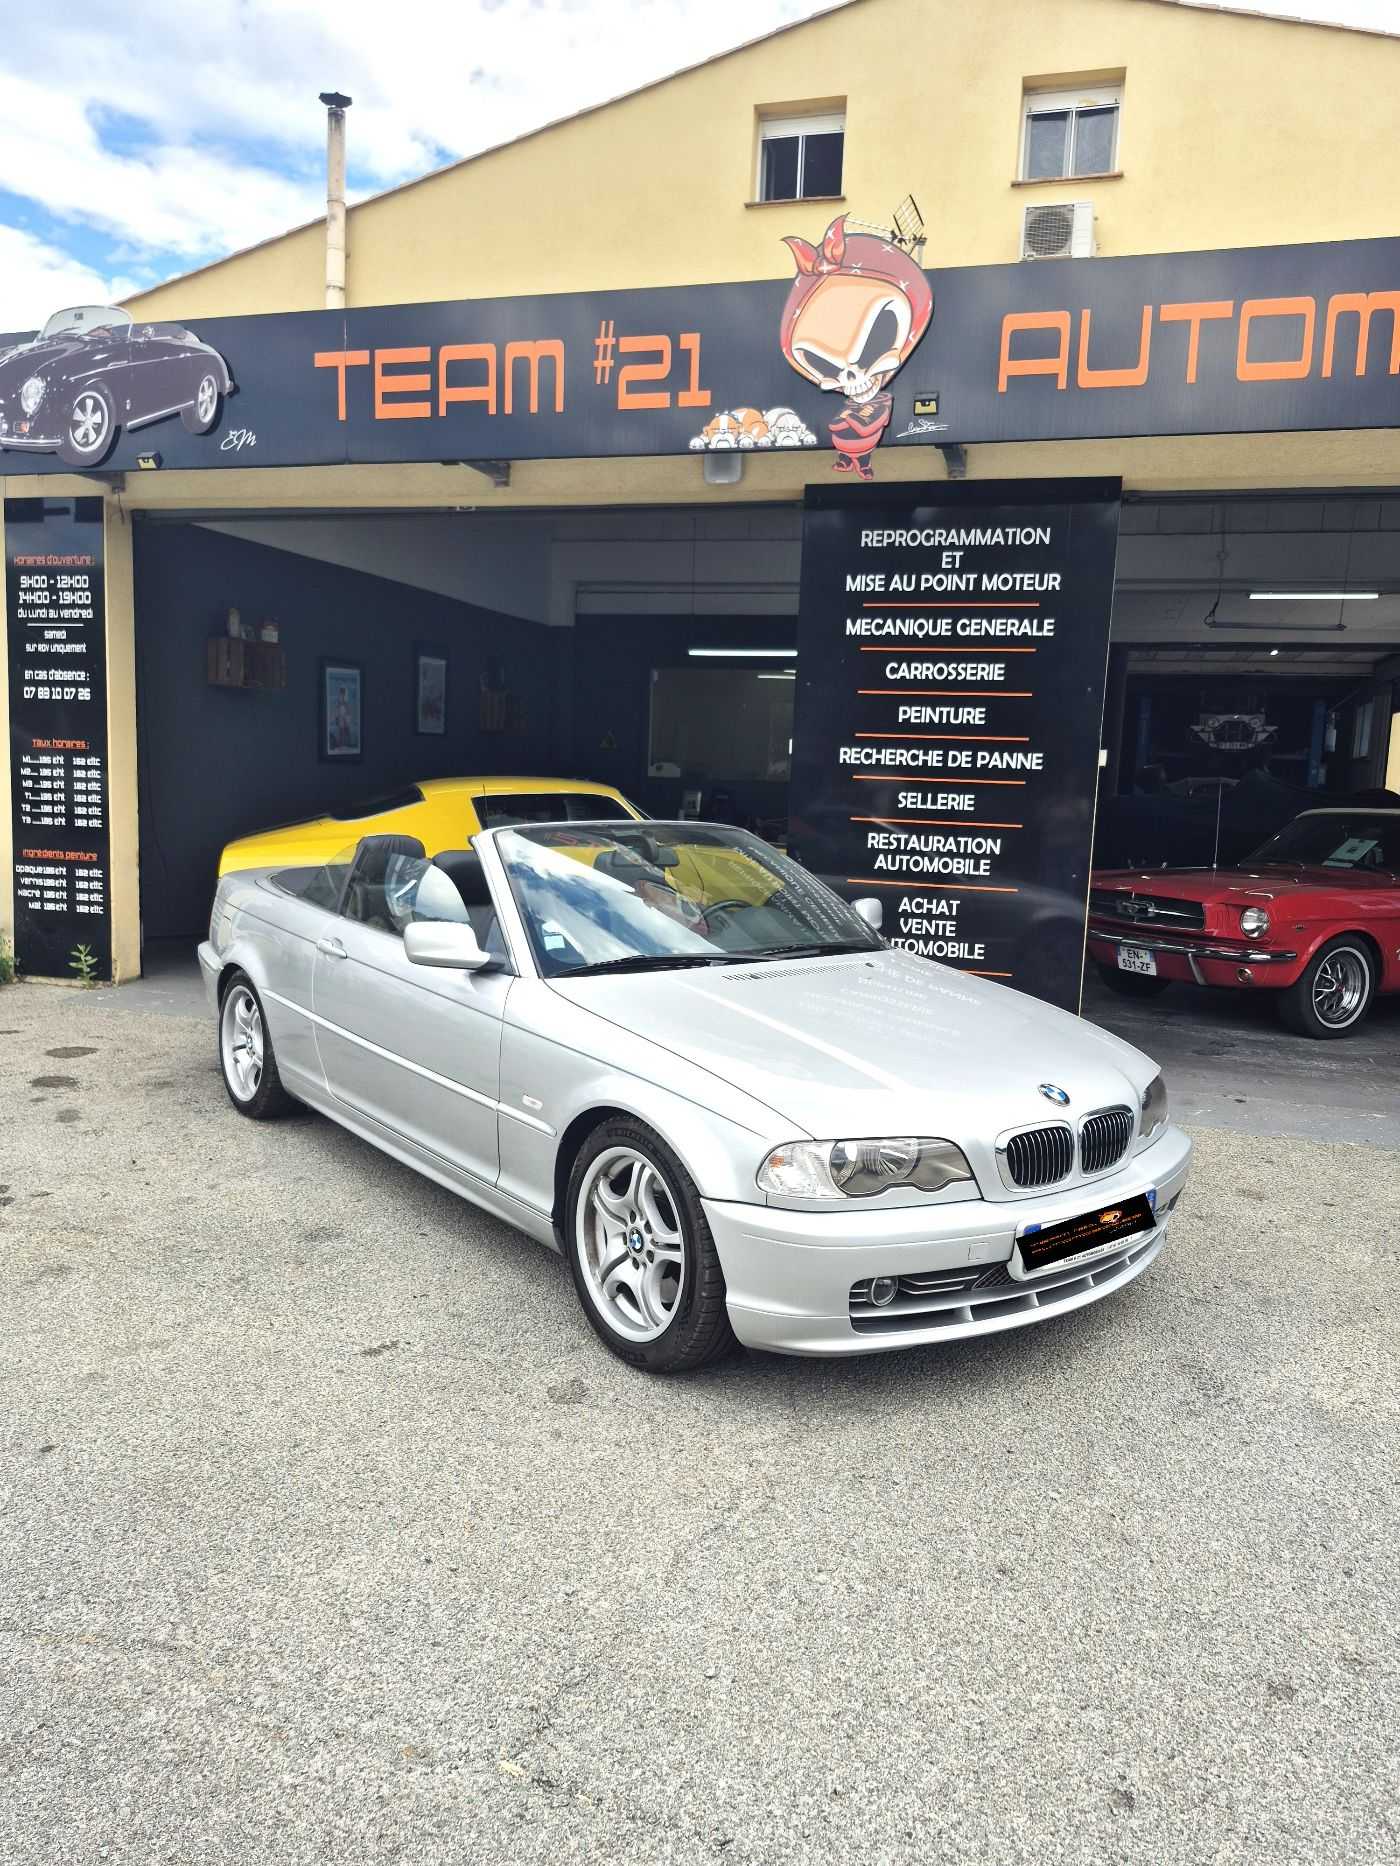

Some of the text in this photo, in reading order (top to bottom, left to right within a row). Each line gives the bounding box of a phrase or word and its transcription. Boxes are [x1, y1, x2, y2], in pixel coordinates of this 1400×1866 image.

[998, 290, 1400, 392] AUTOM
[314, 320, 711, 421] TEAM #21
[861, 527, 1051, 547] REPROGRAMMATION
[941, 551, 963, 568] ET
[20, 575, 47, 588] 9H00
[56, 575, 89, 588] 12H00
[845, 573, 1061, 591] MISE AU POINT MOTEUR
[19, 591, 50, 604] 14H00
[59, 591, 92, 604] 19H00
[845, 618, 1055, 638] MECANIQUE GENERALE
[885, 662, 1005, 681] CARROSSERIE
[24, 686, 36, 699] 07
[51, 687, 62, 700] 10
[63, 687, 76, 700] 07
[898, 706, 986, 724] PEINTURE
[839, 748, 1044, 770] RECHERCHE DE PANNE
[897, 792, 975, 811] SELLERIE
[867, 832, 1001, 855] RESTAURATION
[873, 854, 991, 876] AUTOMOBILE
[898, 897, 960, 916] ACHAT
[900, 918, 957, 937] VENTE
[891, 938, 985, 960] TOMOBILE
